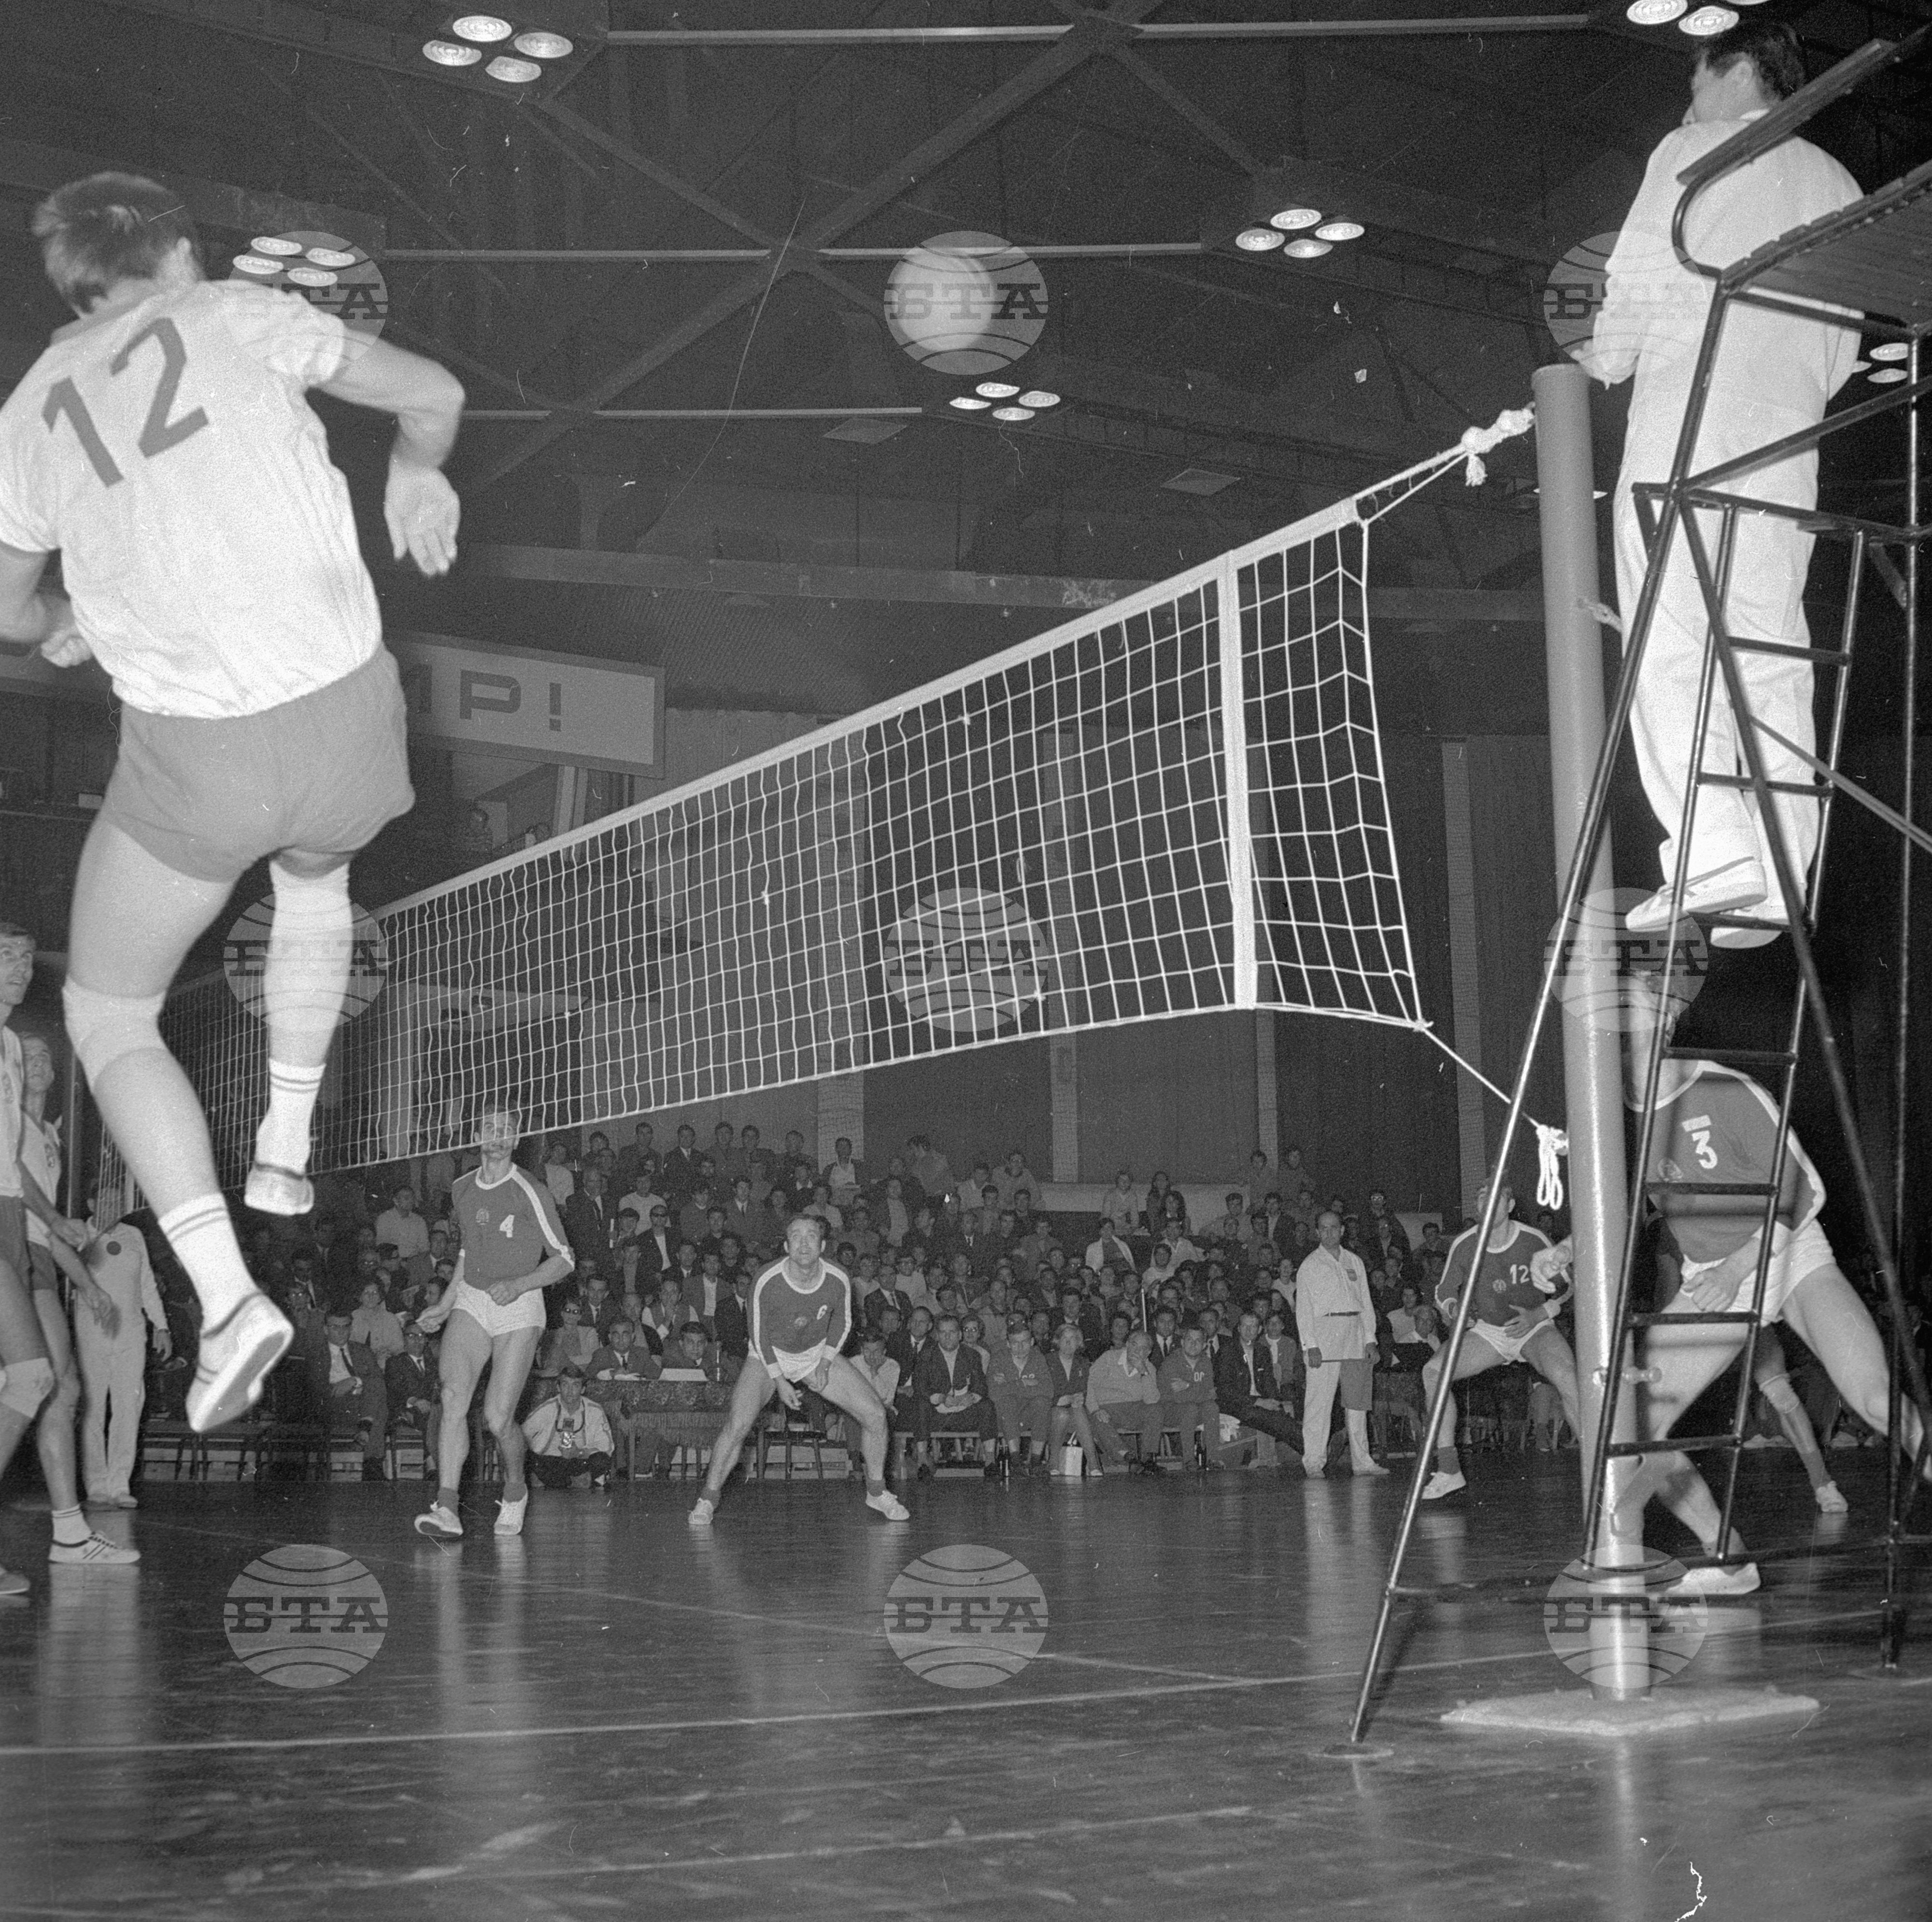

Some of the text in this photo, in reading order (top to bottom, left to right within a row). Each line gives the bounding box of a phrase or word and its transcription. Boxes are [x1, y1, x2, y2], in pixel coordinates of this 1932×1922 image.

[42, 317, 209, 488] 12
[1691, 1130, 1718, 1169] 3
[499, 1214, 515, 1238] 4
[1510, 1264, 1530, 1285] 12
[816, 1304, 828, 1320] 6
